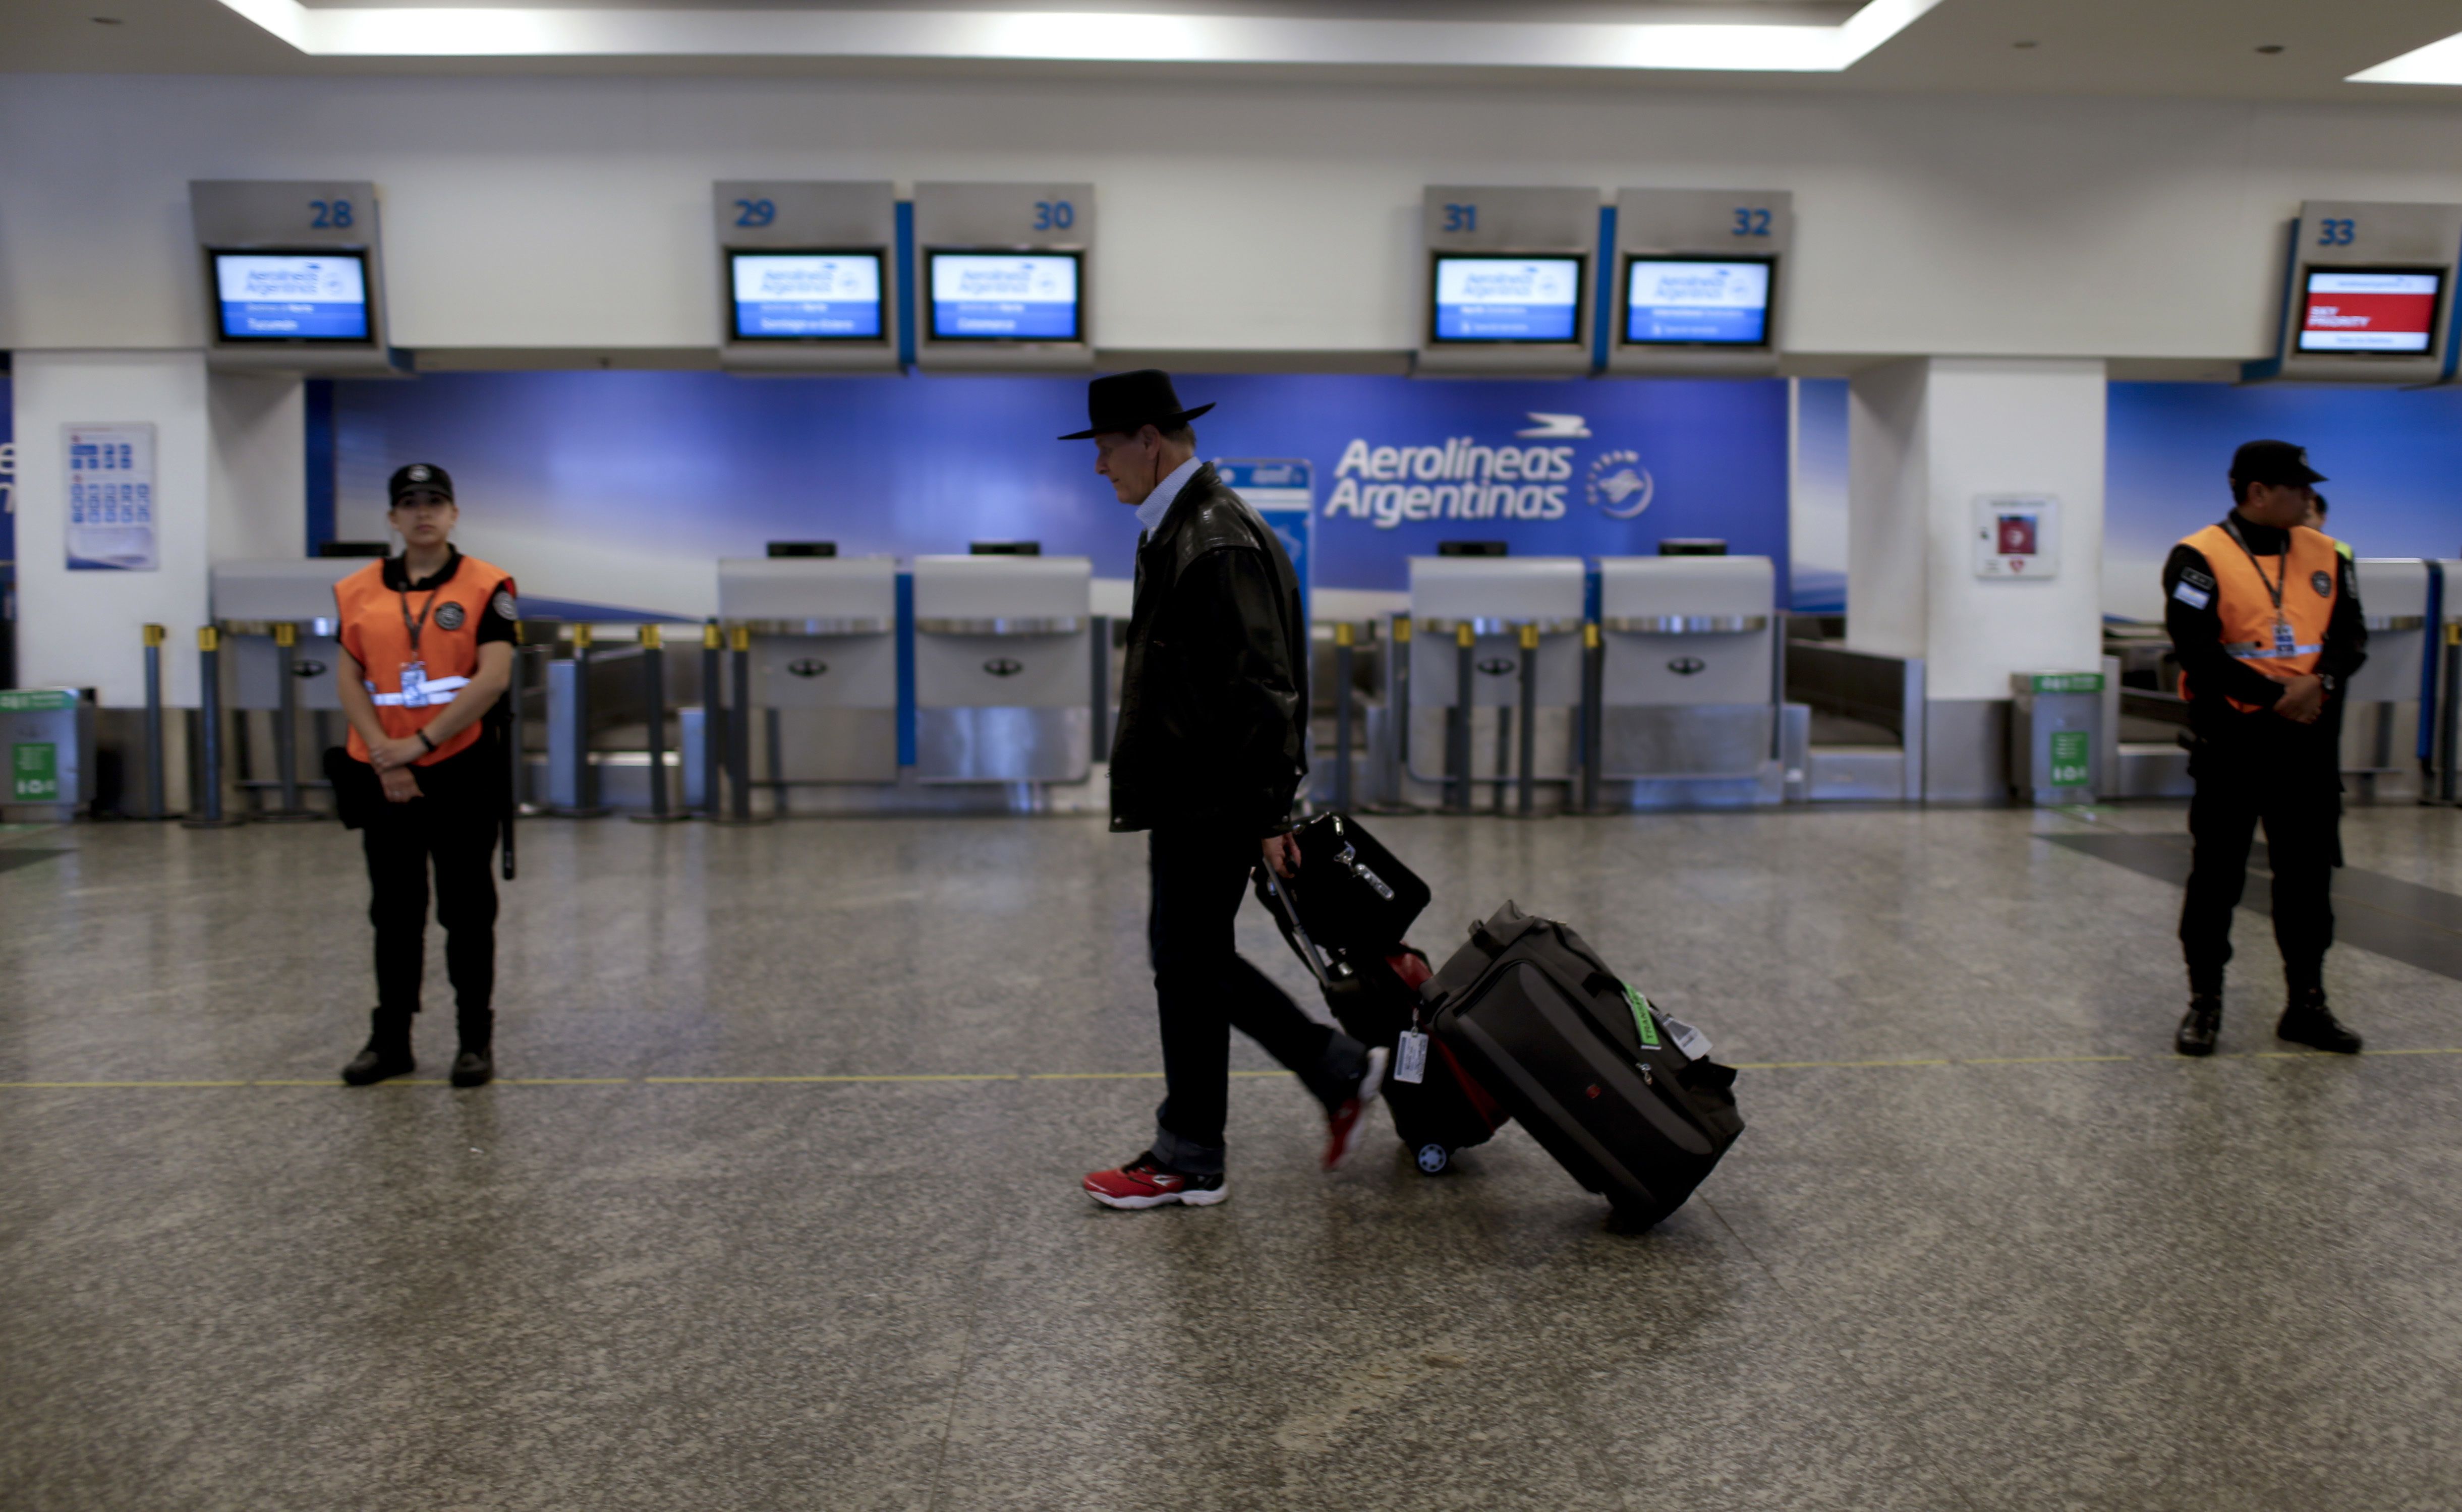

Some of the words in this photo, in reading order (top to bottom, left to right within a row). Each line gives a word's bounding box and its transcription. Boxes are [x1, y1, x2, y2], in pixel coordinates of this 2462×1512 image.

[309, 199, 354, 228] 28
[735, 199, 776, 227] 29
[1033, 201, 1075, 230] 30
[1443, 204, 1476, 231] 31
[1732, 208, 1772, 236] 32
[2318, 219, 2356, 245] 33
[1334, 436, 1574, 481] Aerolíneas
[1324, 477, 1568, 528] Argentinas
